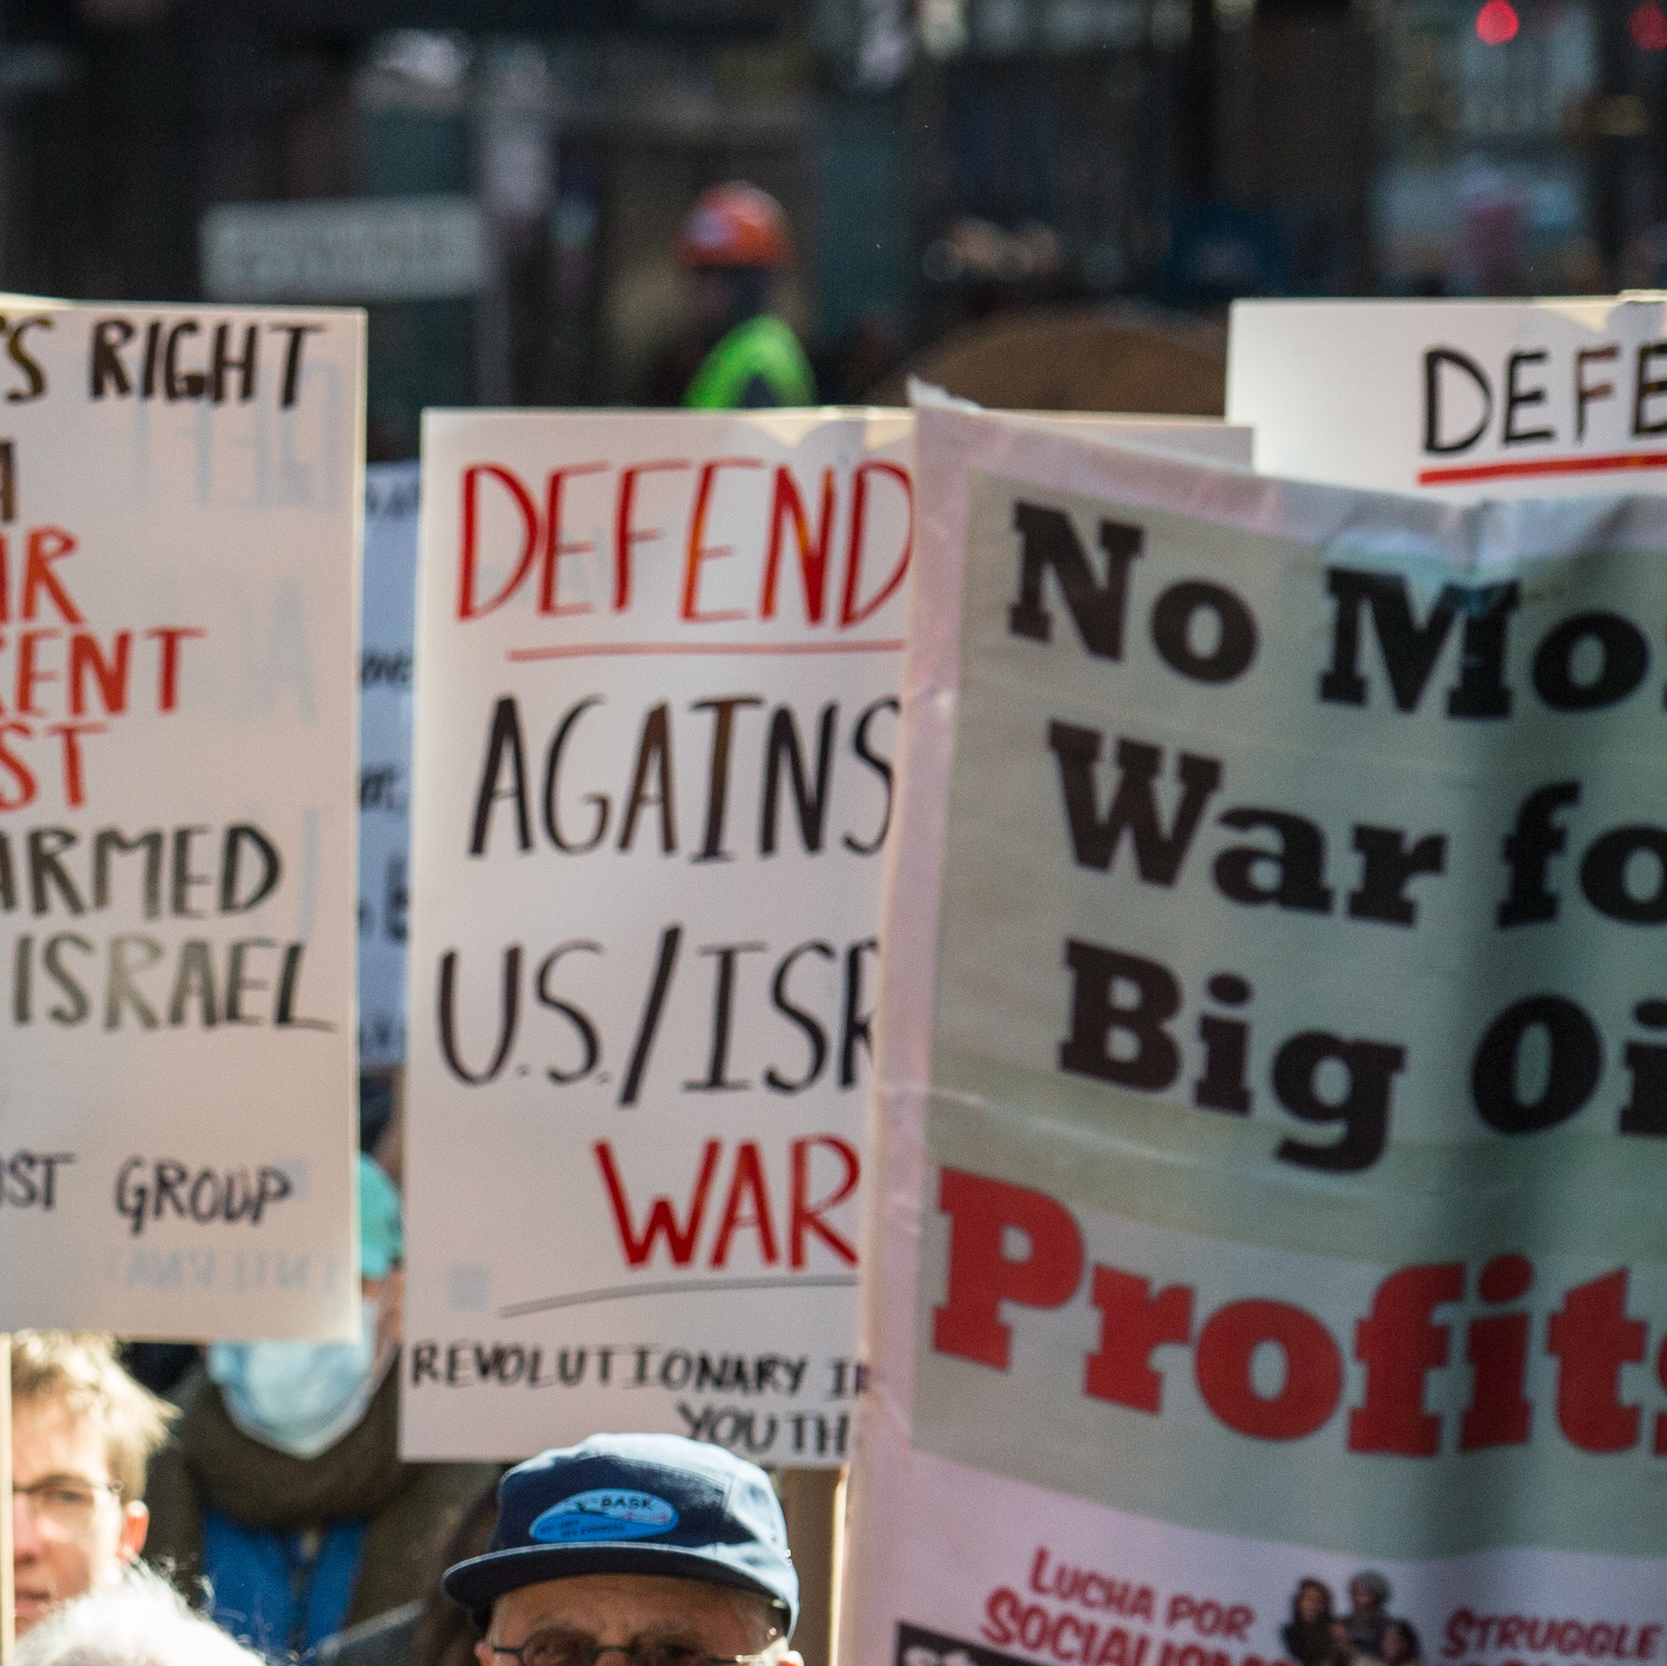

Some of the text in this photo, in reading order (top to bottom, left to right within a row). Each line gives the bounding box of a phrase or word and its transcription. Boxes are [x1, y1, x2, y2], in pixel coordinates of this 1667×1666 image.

[87, 317, 330, 410] RIGHT
[454, 456, 916, 632] DEFEND
[1007, 501, 1667, 722] No Mo
[1046, 718, 1450, 930] War
[10, 931, 339, 1036] ISRAEL
[1058, 937, 1408, 1175] Big
[114, 1154, 293, 1236] GROUP
[591, 1133, 862, 1272] WAR
[930, 1164, 1667, 1459] Profit
[409, 1339, 808, 1397] REVOLUTIONARY
[675, 1401, 851, 1459] YOUTH
[1027, 1545, 1257, 1645] LUCHA POR
[1441, 1604, 1665, 1661] STRUGGLE
